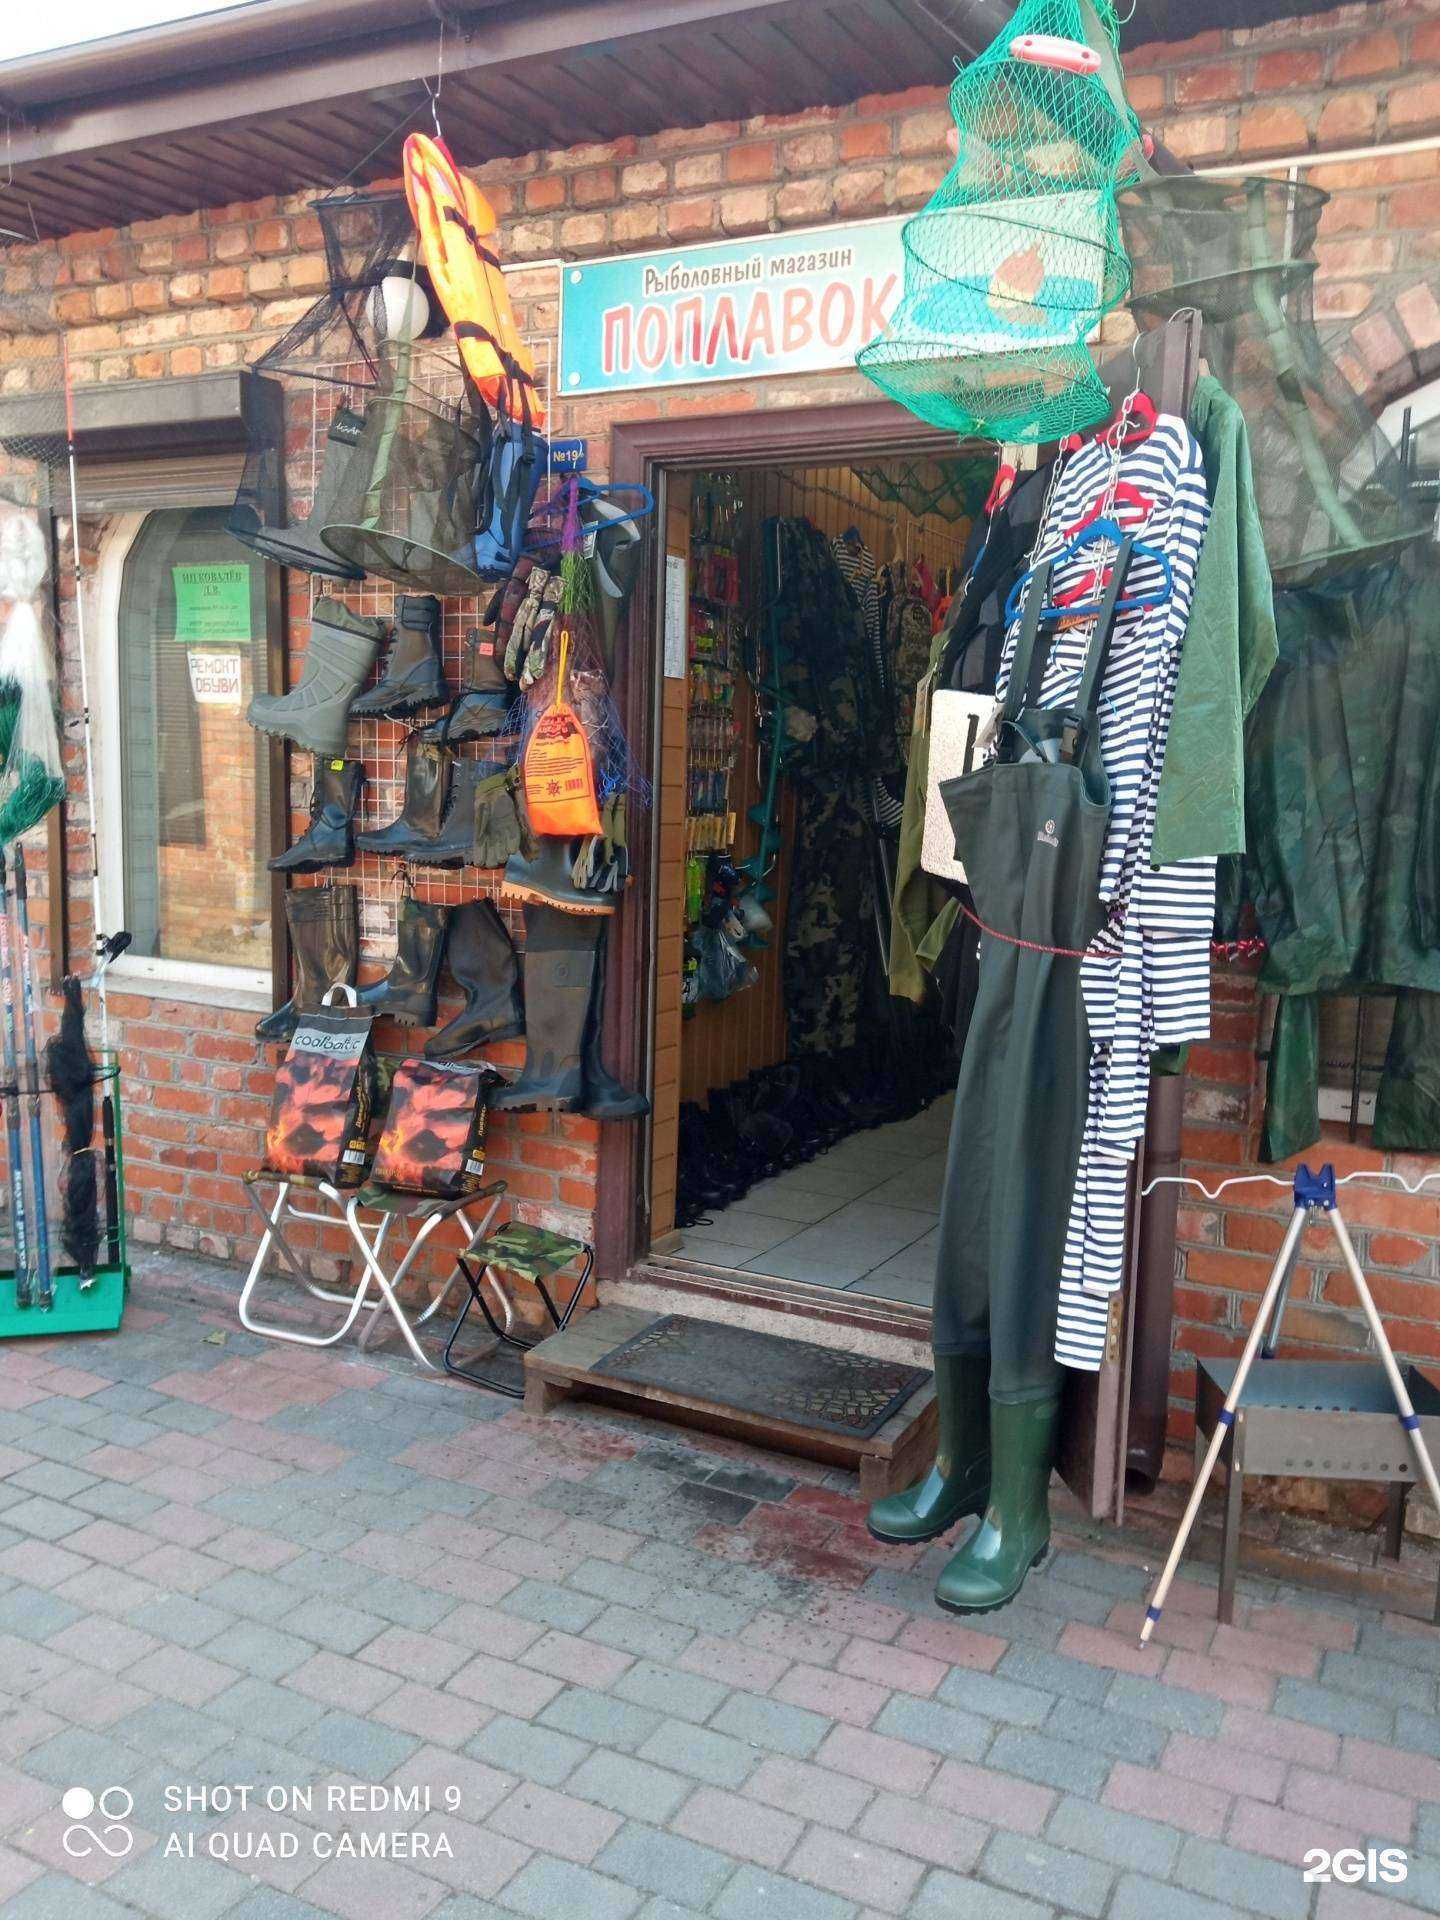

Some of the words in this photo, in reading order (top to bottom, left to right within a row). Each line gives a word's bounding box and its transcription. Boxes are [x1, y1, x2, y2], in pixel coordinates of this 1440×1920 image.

[645, 258, 762, 294] Рыболовный
[770, 249, 852, 277] магазин
[604, 273, 898, 373] ПОПЛАВОК
[190, 658, 239, 674] РЕМОНТ
[195, 677, 239, 694] ОБУВИ
